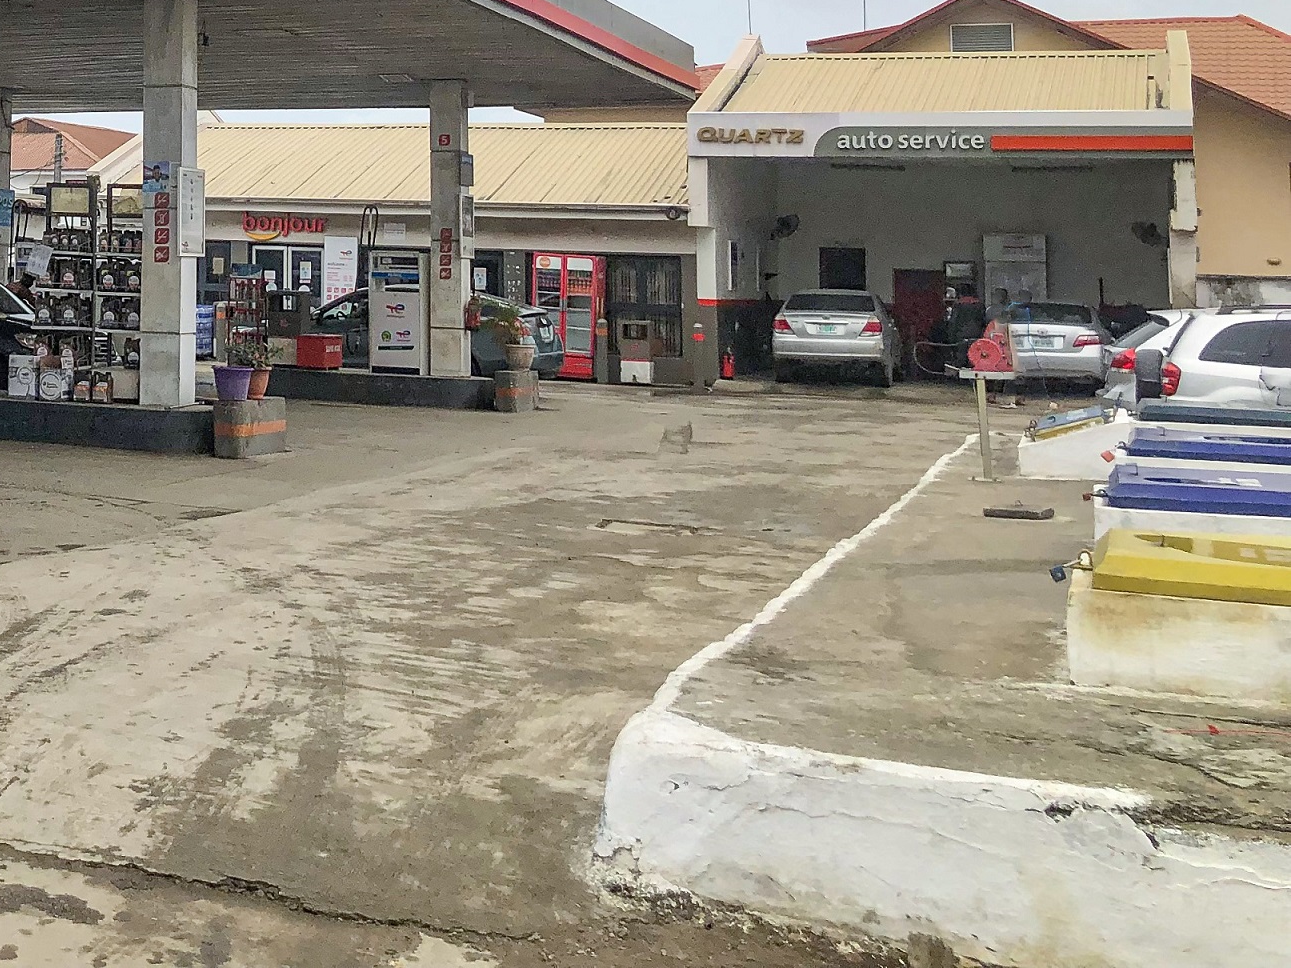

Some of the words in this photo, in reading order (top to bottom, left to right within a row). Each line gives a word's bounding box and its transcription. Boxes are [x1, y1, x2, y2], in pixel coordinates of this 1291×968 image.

[696, 126, 805, 144] QUARTZ
[836, 131, 893, 150] auto
[897, 128, 985, 150] service
[242, 211, 325, 238] bonjour
